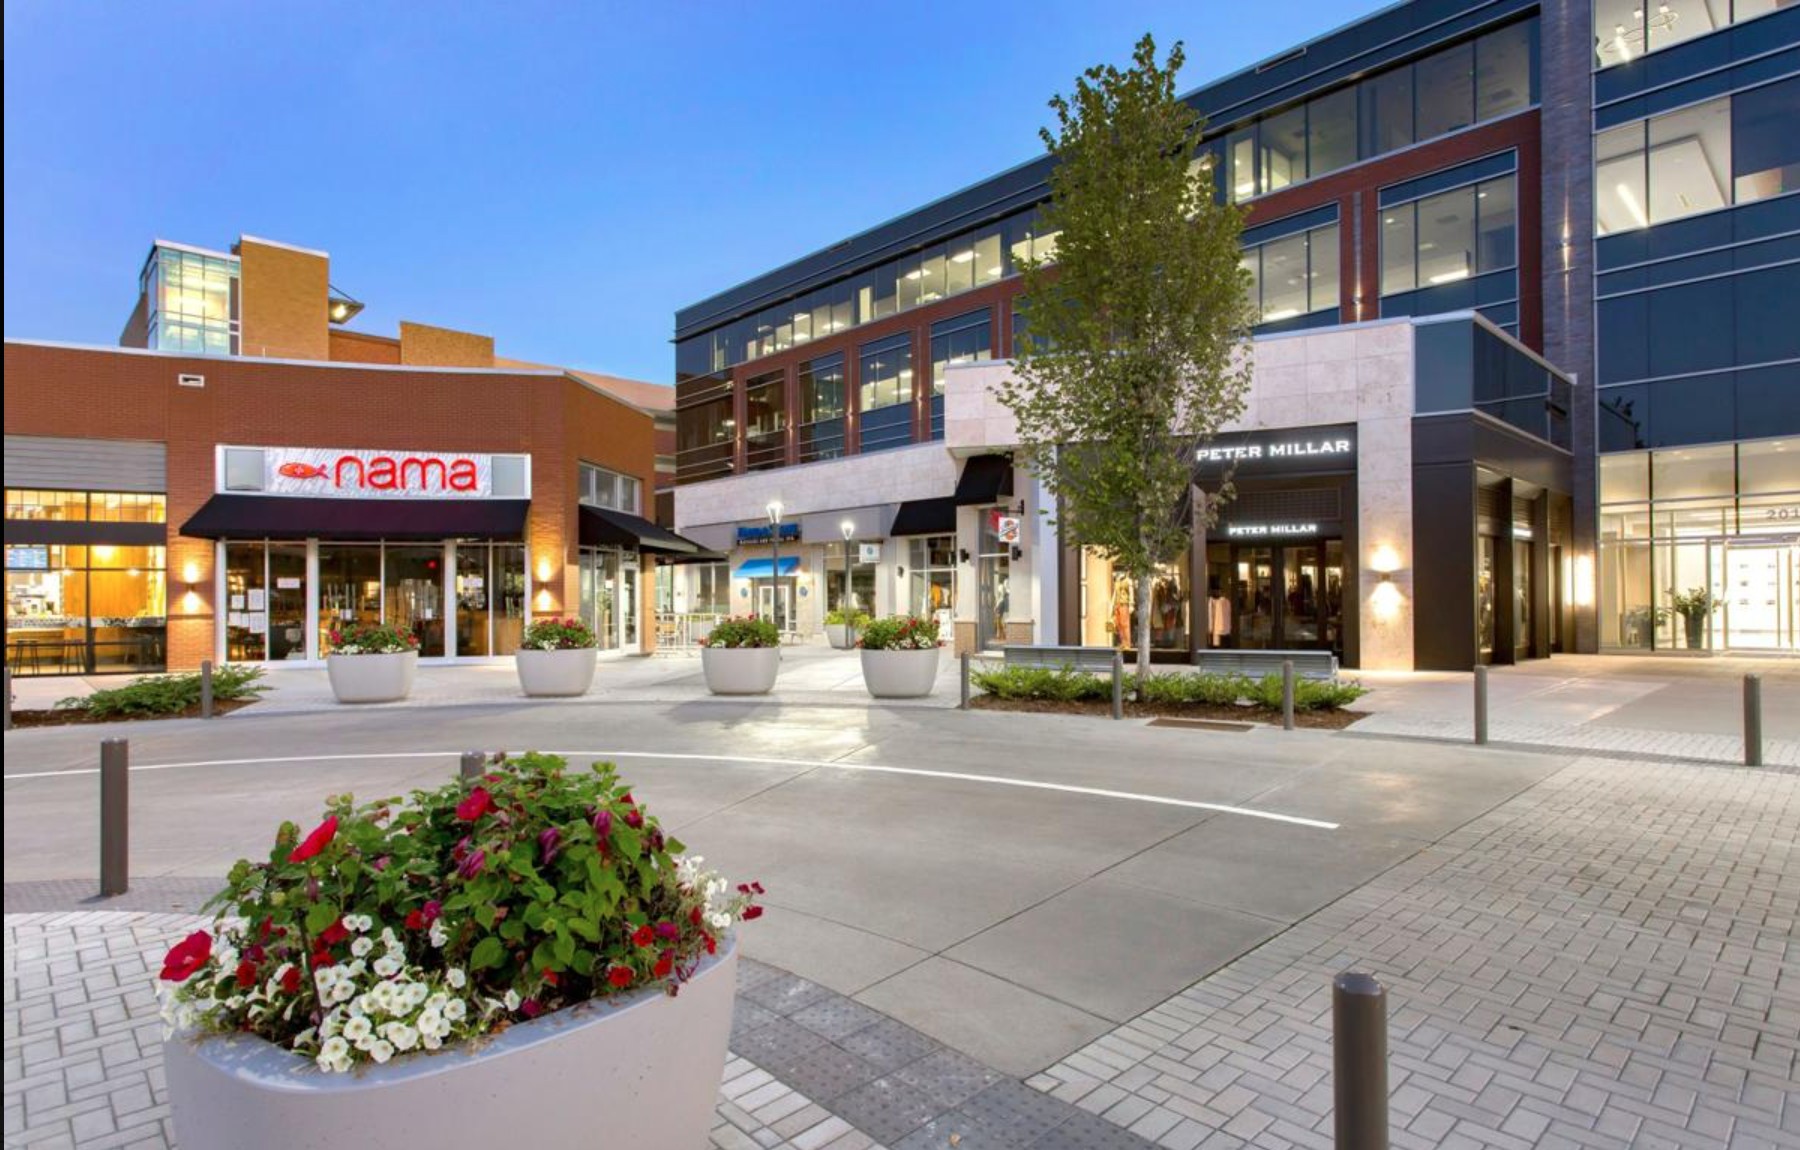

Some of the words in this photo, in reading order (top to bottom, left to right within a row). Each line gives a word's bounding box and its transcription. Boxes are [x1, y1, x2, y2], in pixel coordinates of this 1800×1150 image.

[1197, 446, 1262, 461] PETER
[1269, 440, 1350, 457] MILLAR
[335, 456, 477, 491] nama
[1228, 525, 1268, 535] PETER
[1270, 523, 1317, 534] MILLAR
